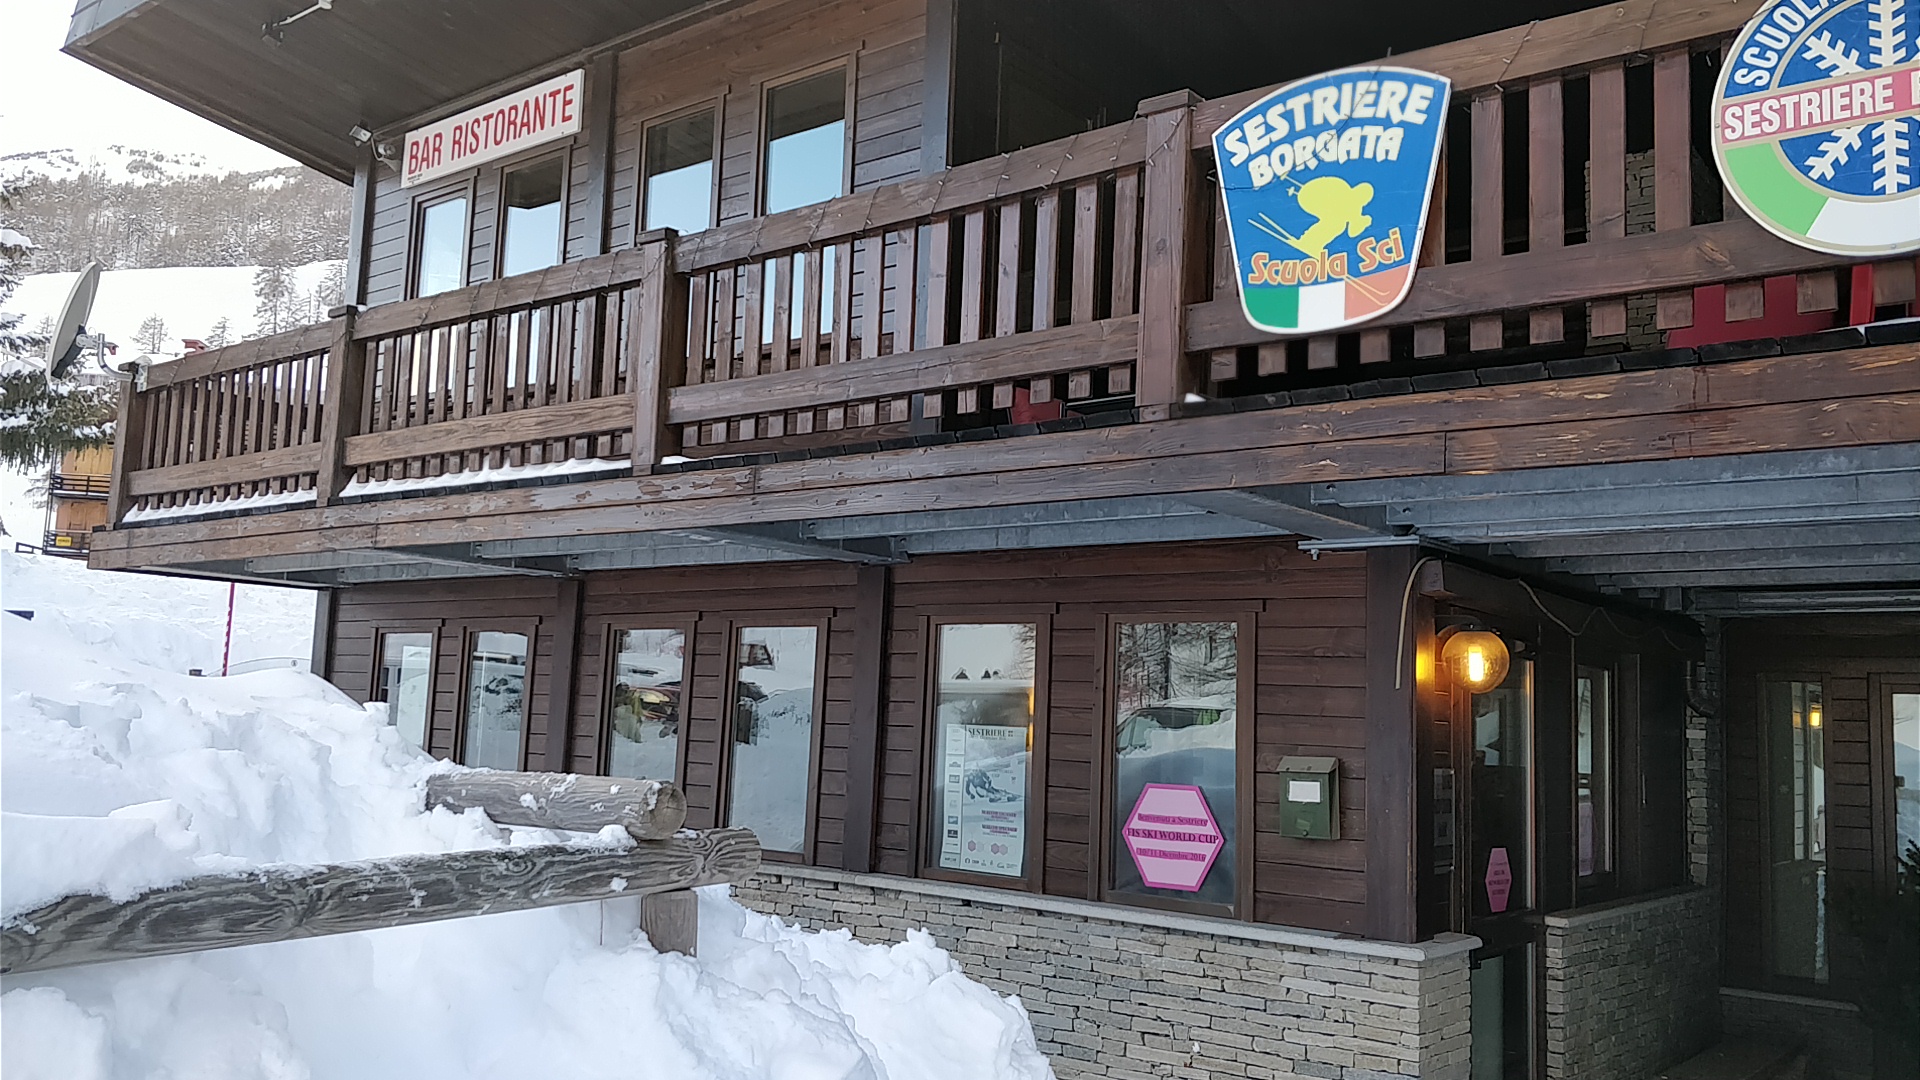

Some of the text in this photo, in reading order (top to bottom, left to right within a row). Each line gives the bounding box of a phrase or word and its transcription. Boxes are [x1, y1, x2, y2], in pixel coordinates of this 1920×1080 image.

[408, 83, 574, 175] BAR RISTORANTE
[1224, 80, 1435, 167] SESTRIERE
[1724, 76, 1894, 140] SESTRIERE
[1248, 125, 1404, 190] BORGATA
[1249, 227, 1405, 285] Scuola Sci
[1127, 828, 1219, 844] FIS SKI WORLD CUP
